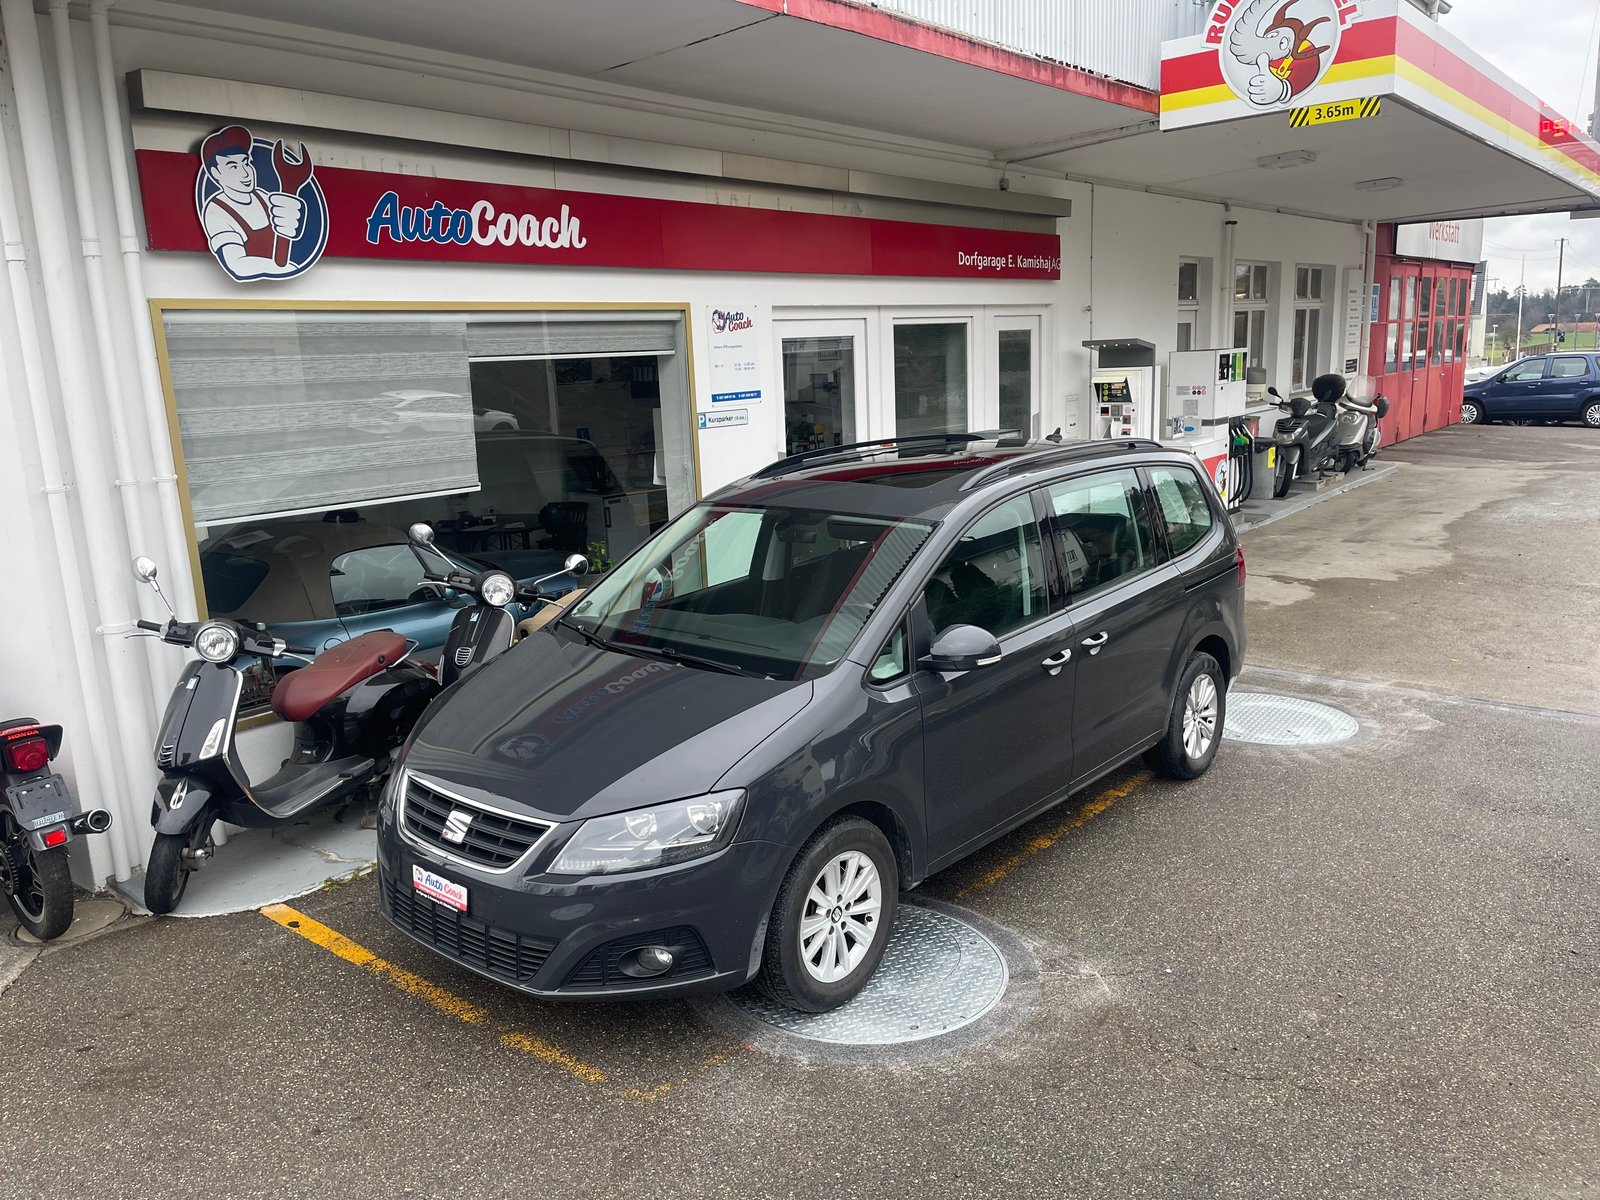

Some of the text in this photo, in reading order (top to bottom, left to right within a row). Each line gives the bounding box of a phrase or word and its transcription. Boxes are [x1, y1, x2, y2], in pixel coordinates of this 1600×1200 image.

[1315, 106, 1354, 120] 3.65m
[366, 191, 587, 249] AutoCoach
[958, 251, 1006, 271] Dorfgarage
[1008, 254, 1015, 268] E.
[726, 311, 744, 321] Auto
[728, 316, 753, 332] Coach
[708, 415, 734, 424] Kurzparker
[8, 730, 39, 740] HONDA
[425, 874, 443, 892] Auto
